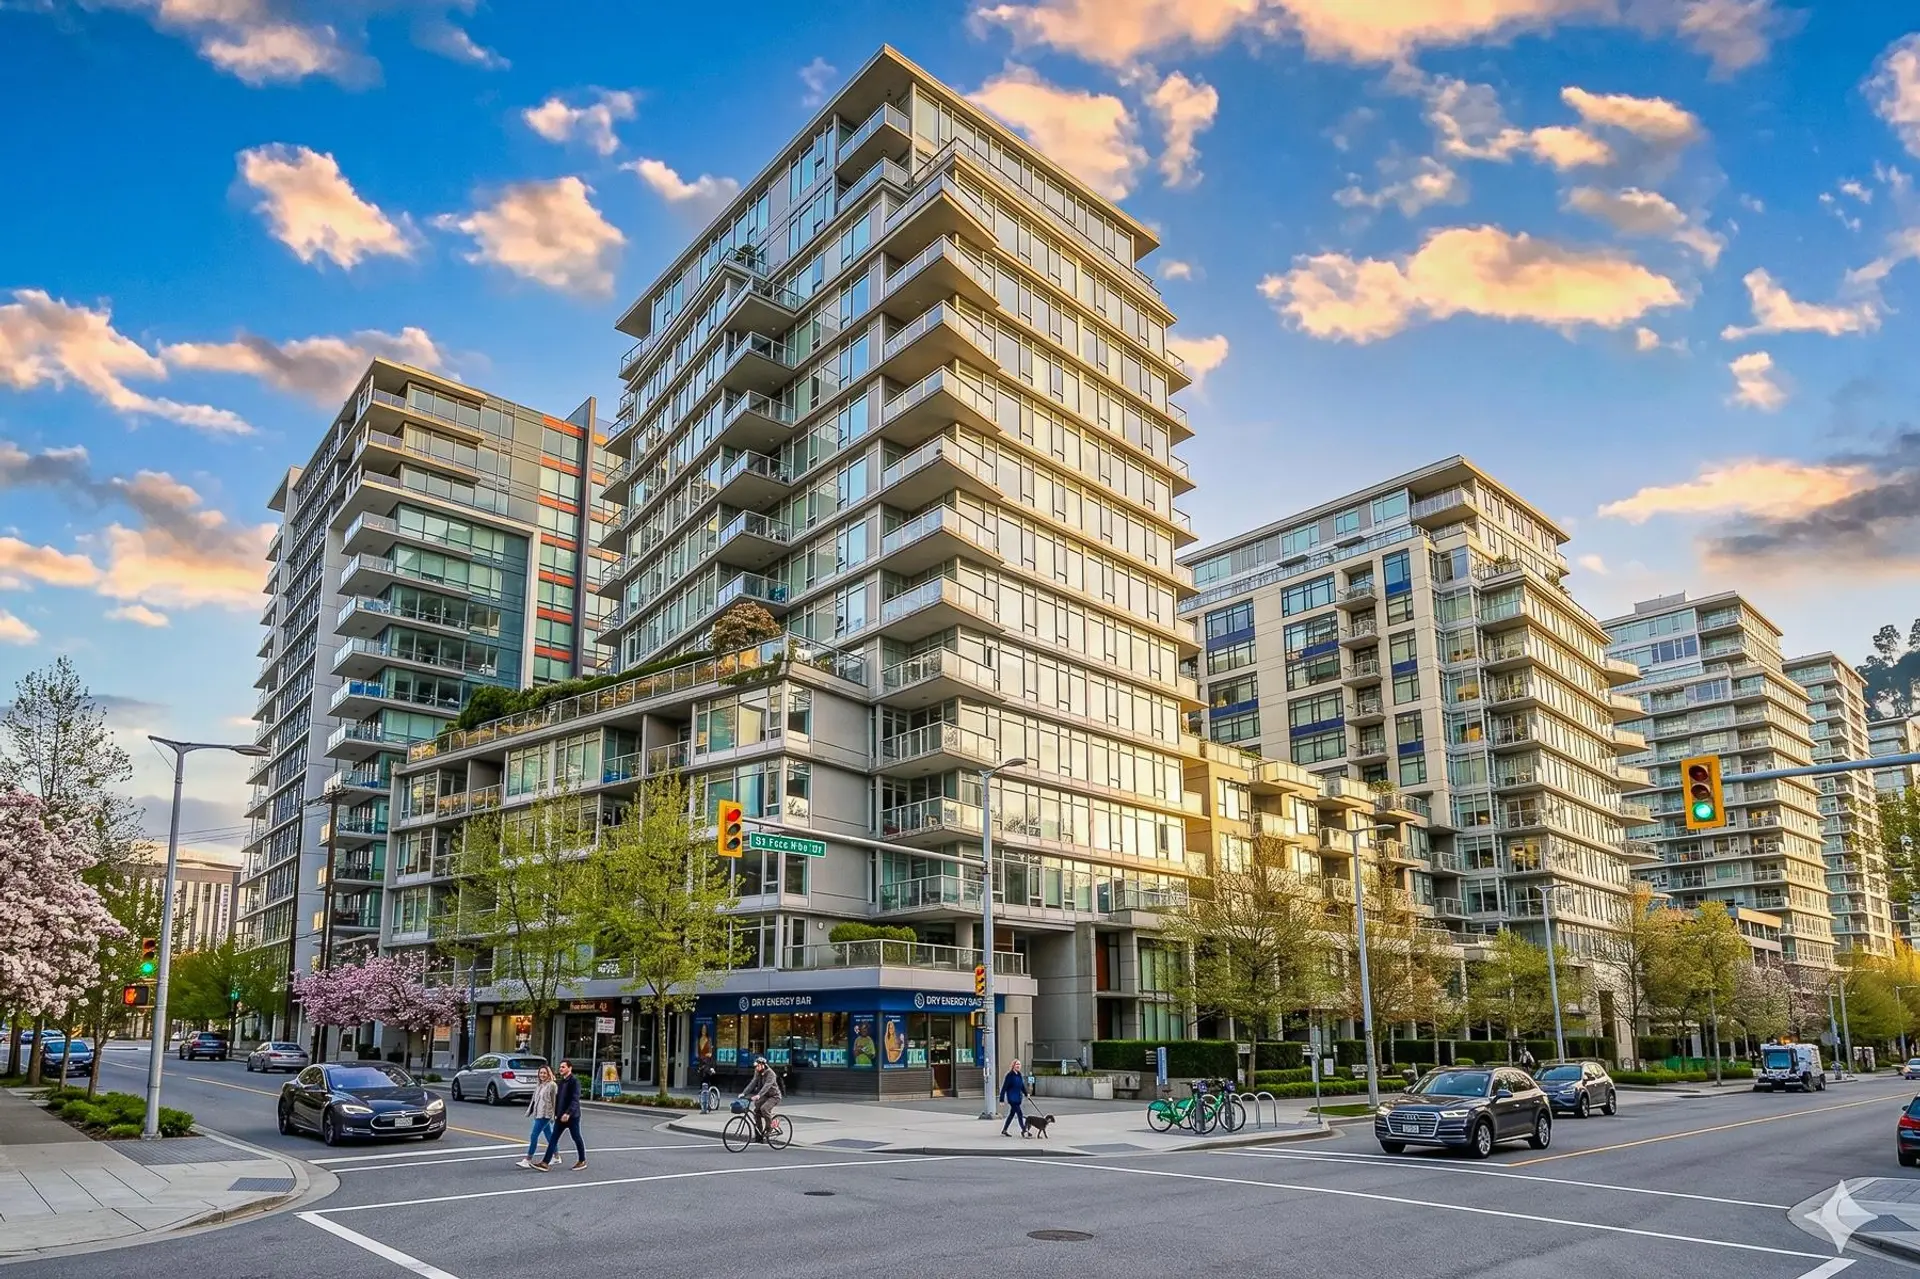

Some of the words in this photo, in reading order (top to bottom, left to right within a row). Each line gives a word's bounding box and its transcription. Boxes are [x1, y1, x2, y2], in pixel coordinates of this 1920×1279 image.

[751, 998, 765, 1007] DRY
[766, 997, 795, 1006] ENERGY
[795, 996, 812, 1005] BAR
[926, 996, 940, 1005] DRY
[941, 997, 968, 1006] ENERGY
